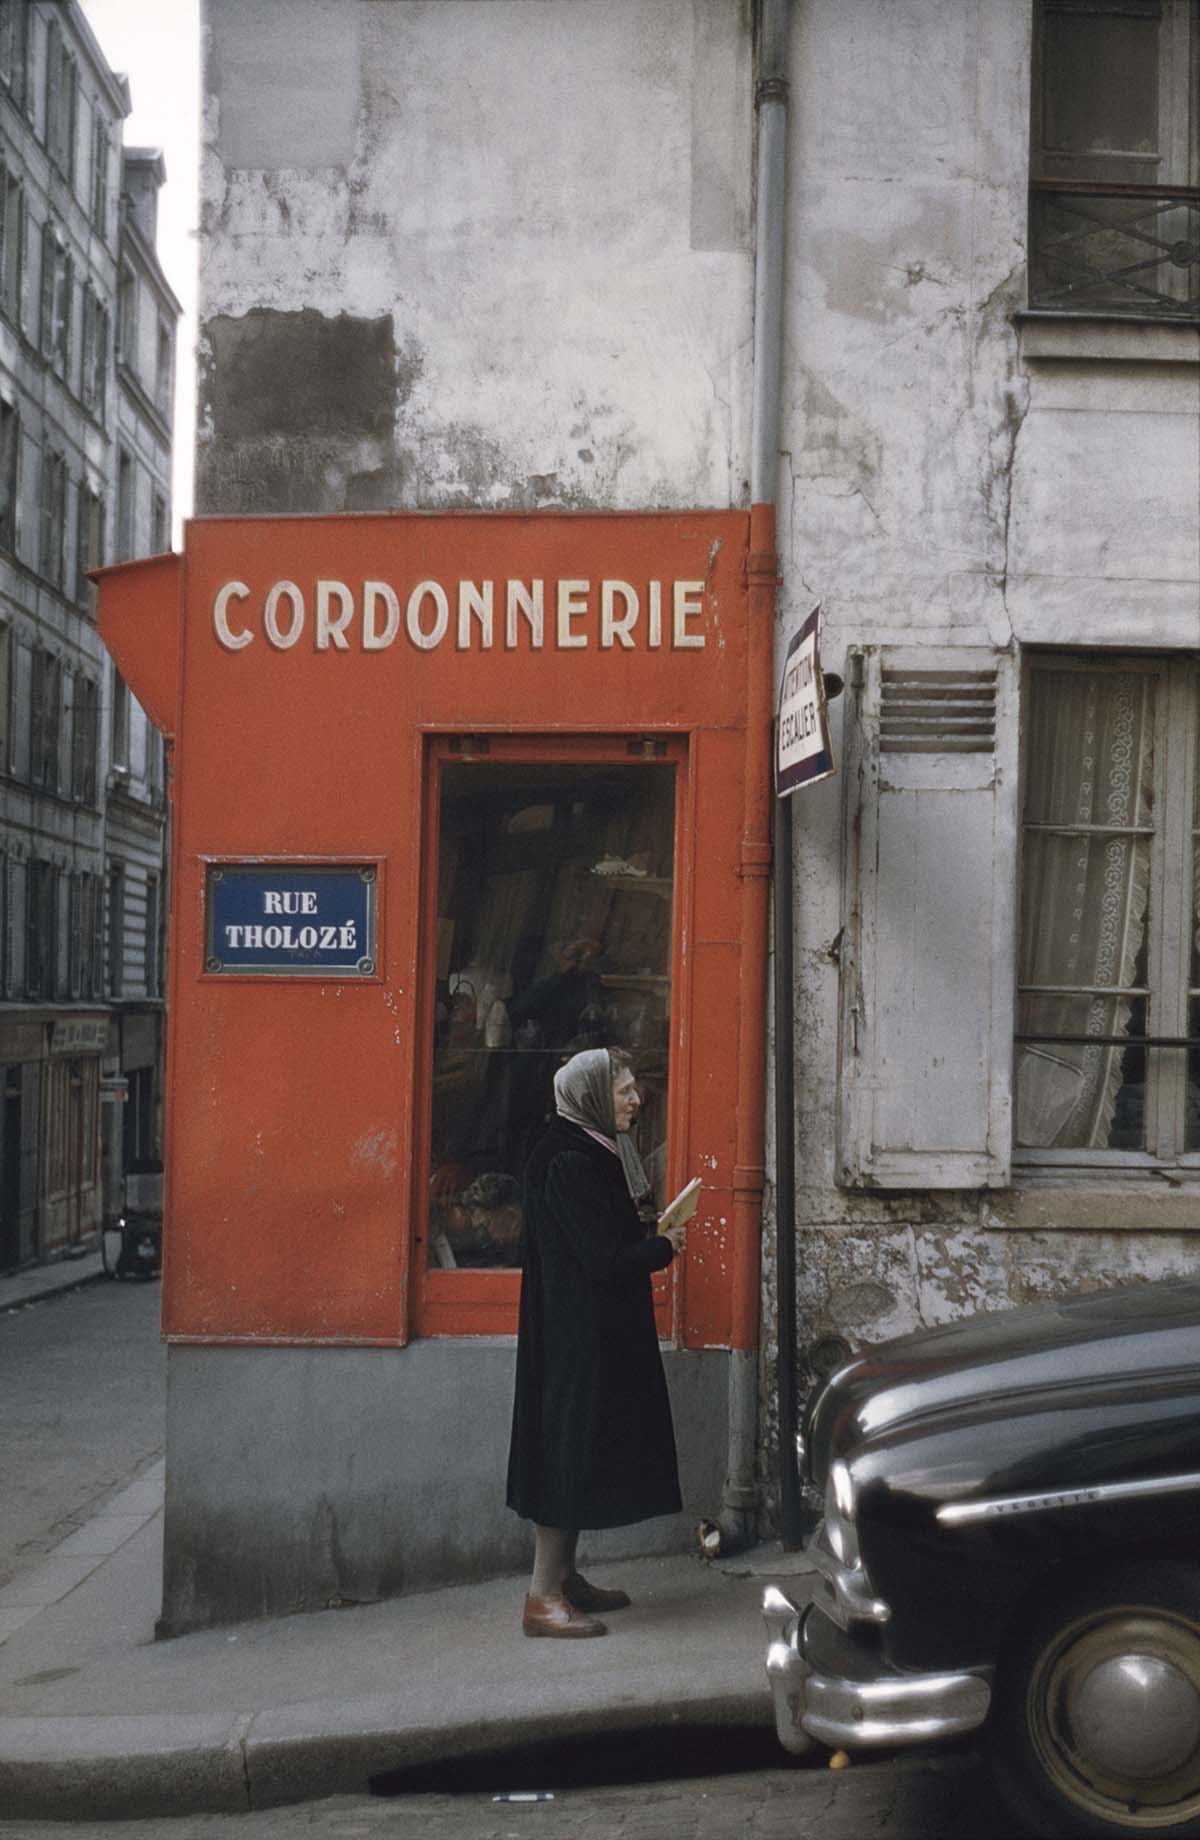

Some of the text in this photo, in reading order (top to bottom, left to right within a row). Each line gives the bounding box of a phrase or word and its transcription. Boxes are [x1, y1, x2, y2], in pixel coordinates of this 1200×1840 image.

[213, 579, 706, 650] CORDONNERIE
[782, 702, 817, 750] ESCALIER
[264, 890, 318, 914] RUE
[225, 920, 357, 949] THOLOZÉ
